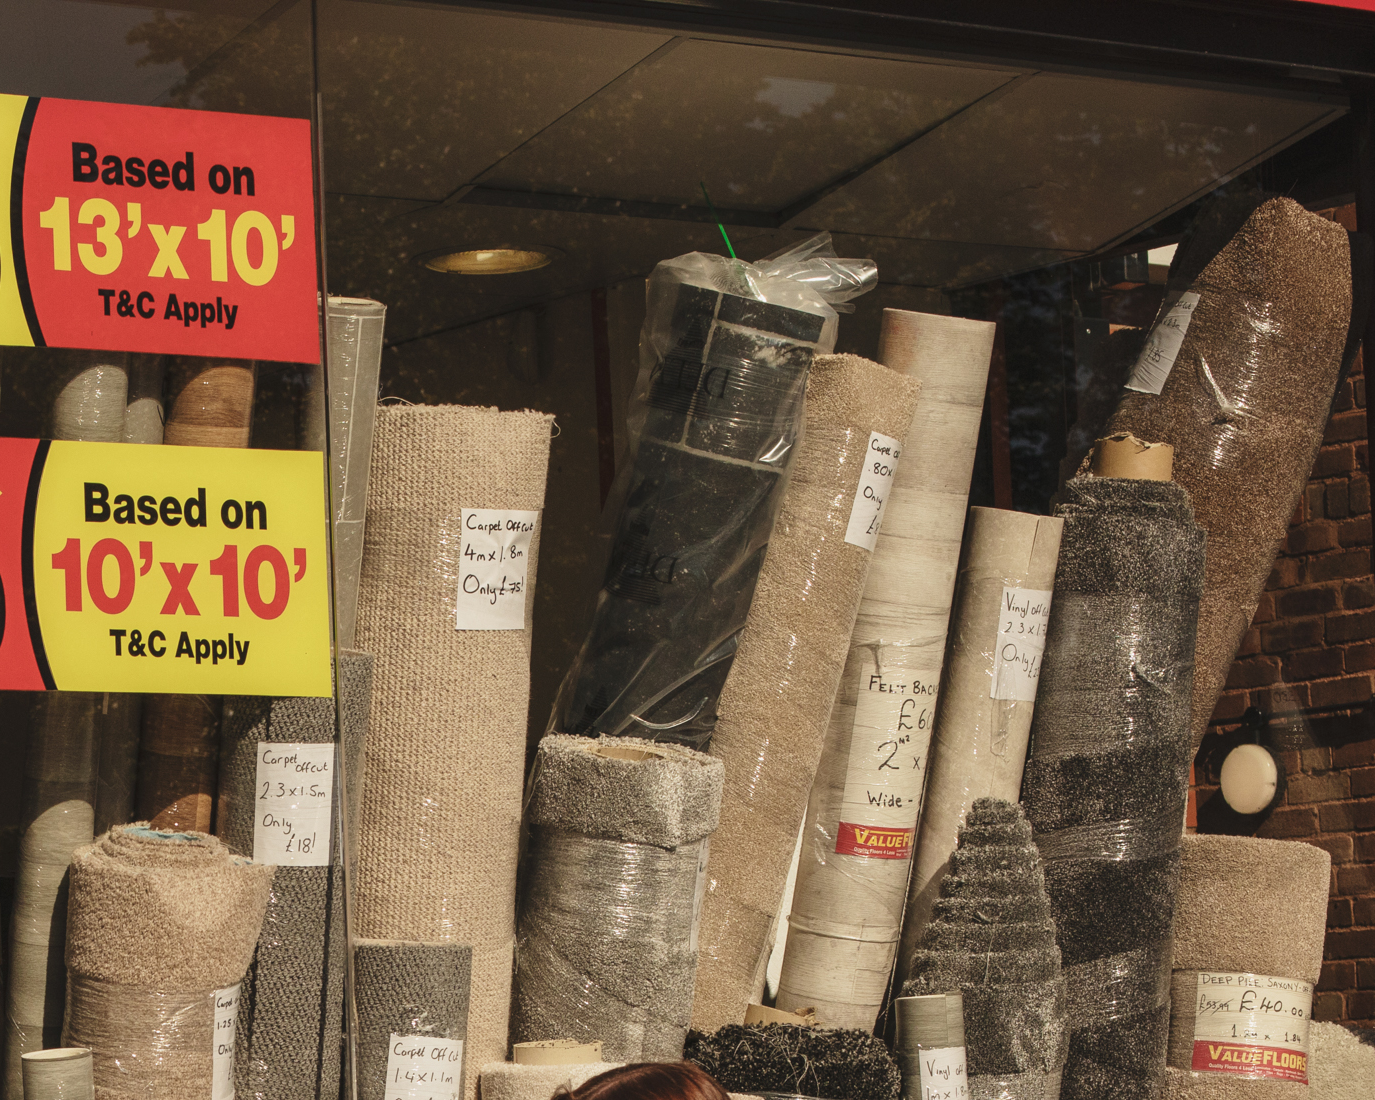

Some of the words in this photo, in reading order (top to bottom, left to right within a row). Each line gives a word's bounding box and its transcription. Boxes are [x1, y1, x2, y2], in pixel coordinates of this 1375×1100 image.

[71, 141, 194, 191] Based
[208, 162, 256, 196] on
[98, 288, 155, 319] T&C
[163, 293, 238, 330] Apply
[84, 482, 207, 529] Based
[221, 497, 267, 530] on
[466, 514, 502, 535] Carpet
[463, 574, 497, 605] Only
[1007, 592, 1029, 618] Vinyl
[109, 629, 165, 657] T&C
[175, 632, 249, 666] Apply
[1002, 644, 1028, 671] Only
[263, 750, 297, 768] Carpet
[867, 791, 903, 807] Wide
[263, 813, 291, 834] Only
[1201, 974, 1232, 984] DEEP
[394, 1042, 425, 1059] Carpet
[926, 1059, 951, 1080] Vinyl
